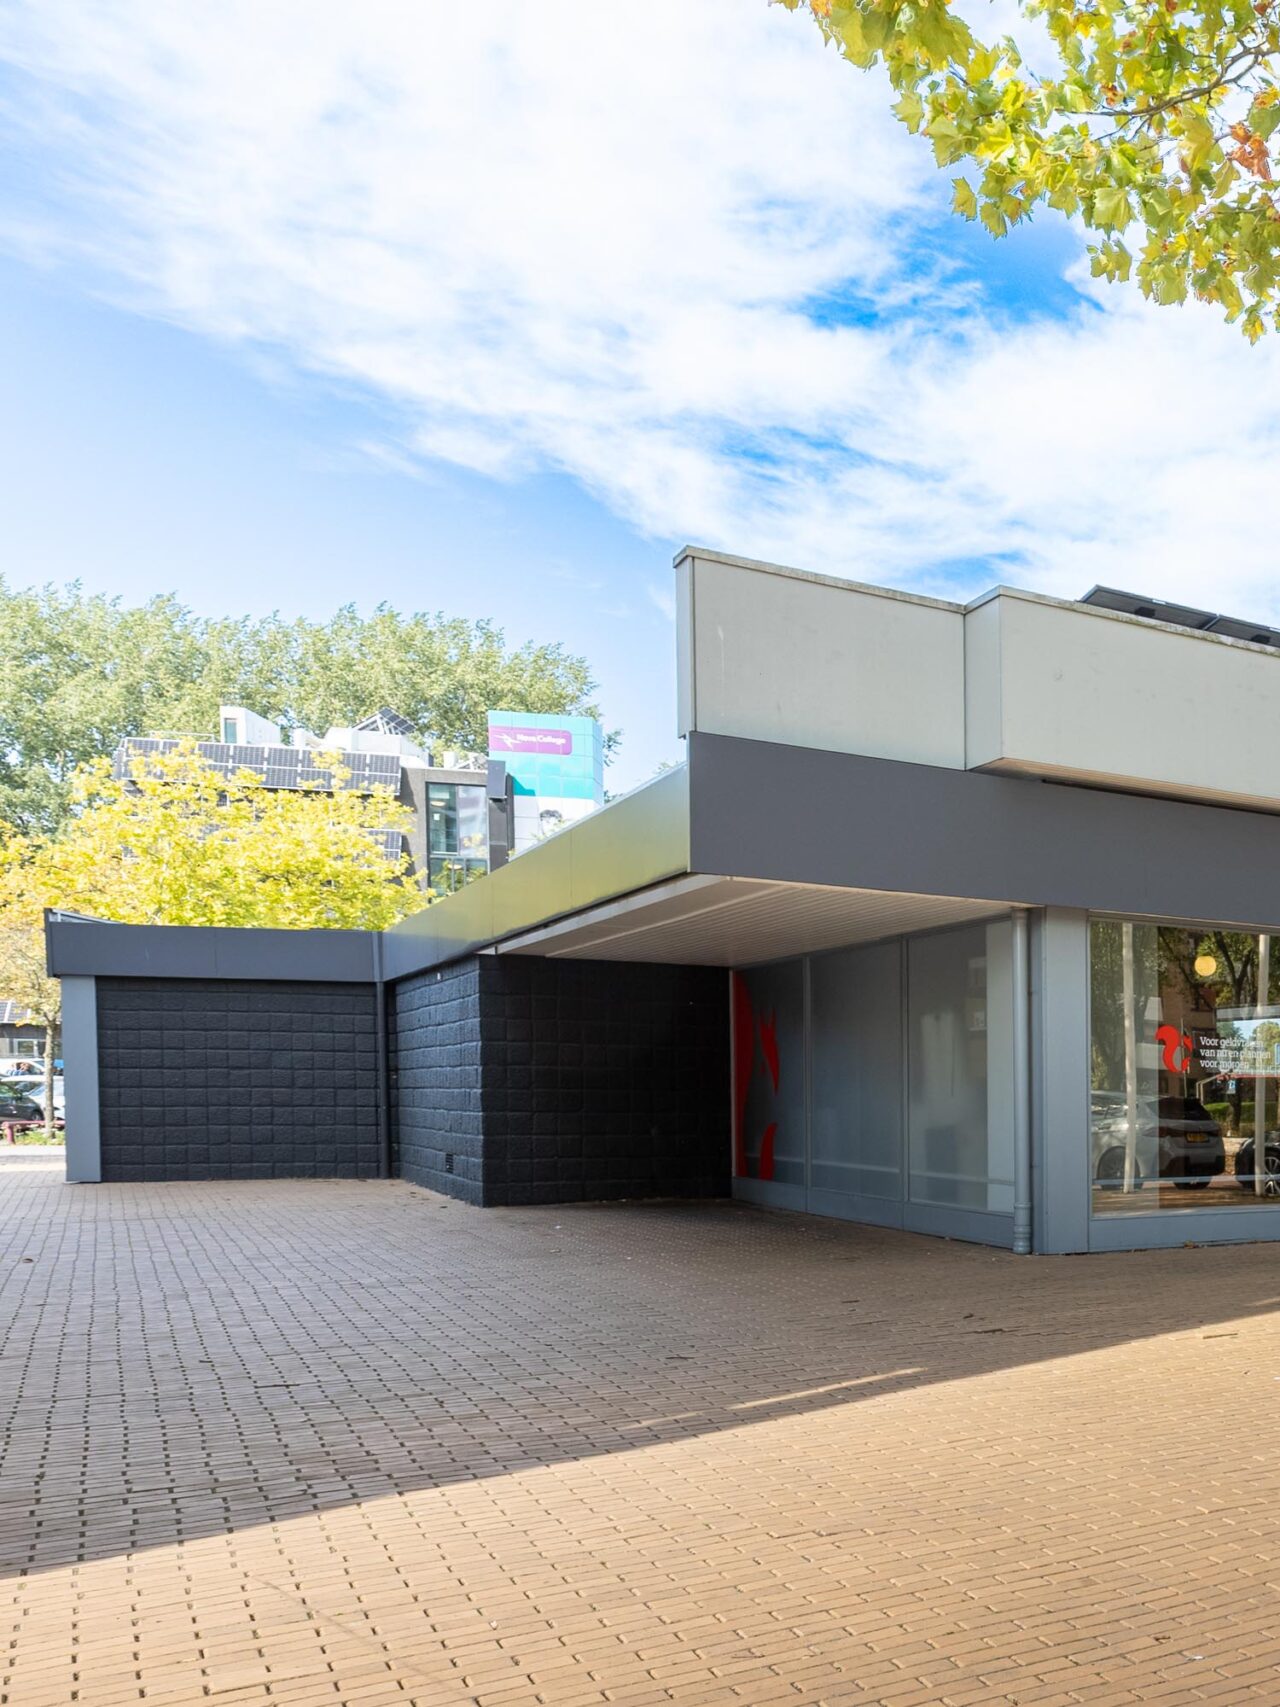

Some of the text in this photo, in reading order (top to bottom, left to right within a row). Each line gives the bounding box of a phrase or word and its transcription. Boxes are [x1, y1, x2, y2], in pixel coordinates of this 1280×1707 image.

[537, 735, 566, 745] College
[1200, 1036, 1218, 1046] Voor
[1200, 1049, 1216, 1057] van
[1200, 1060, 1218, 1068] voor
